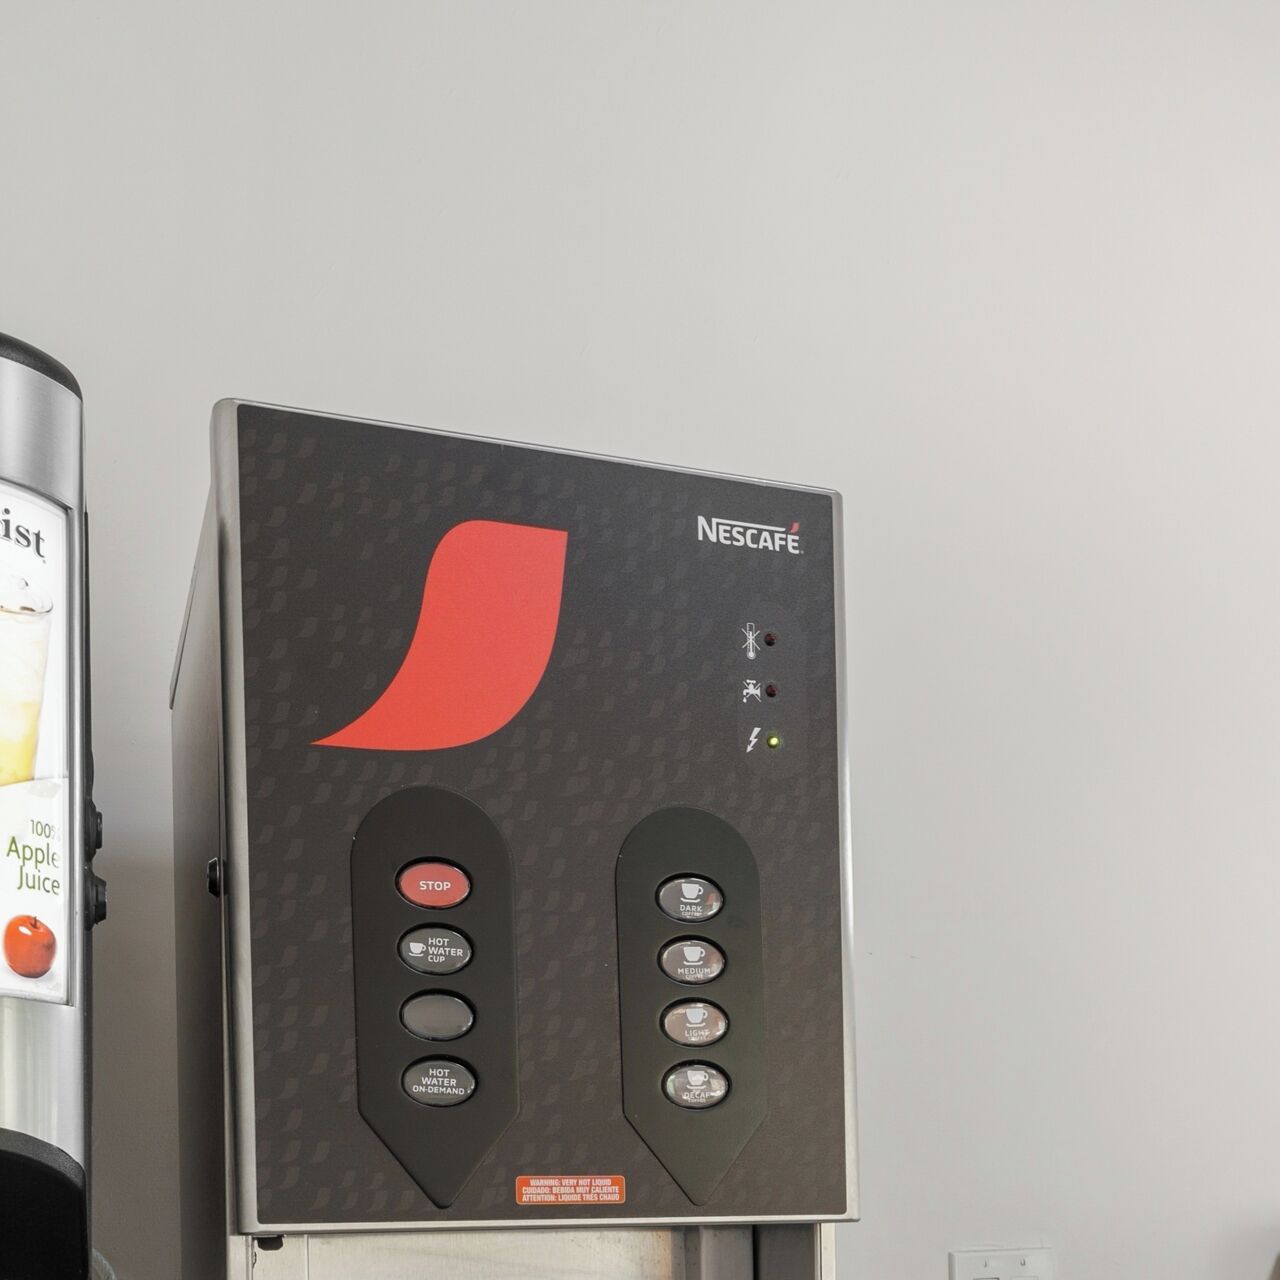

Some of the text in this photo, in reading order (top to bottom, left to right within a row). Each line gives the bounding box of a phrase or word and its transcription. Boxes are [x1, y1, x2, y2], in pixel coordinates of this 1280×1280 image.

[6, 836, 60, 869] Apple
[17, 865, 60, 896] Juice
[419, 880, 451, 891] STOP
[680, 904, 703, 912] DARK
[428, 937, 449, 946] HOT
[428, 946, 463, 957] WATER
[428, 955, 446, 963] CUP
[677, 967, 711, 975] MEDIUM
[684, 1029, 709, 1037] LIGHT
[429, 1068, 450, 1077] HOT
[421, 1077, 457, 1087] WATER
[412, 1085, 465, 1095] ON-DEMAND
[552, 1186, 575, 1194] BEBIDA
